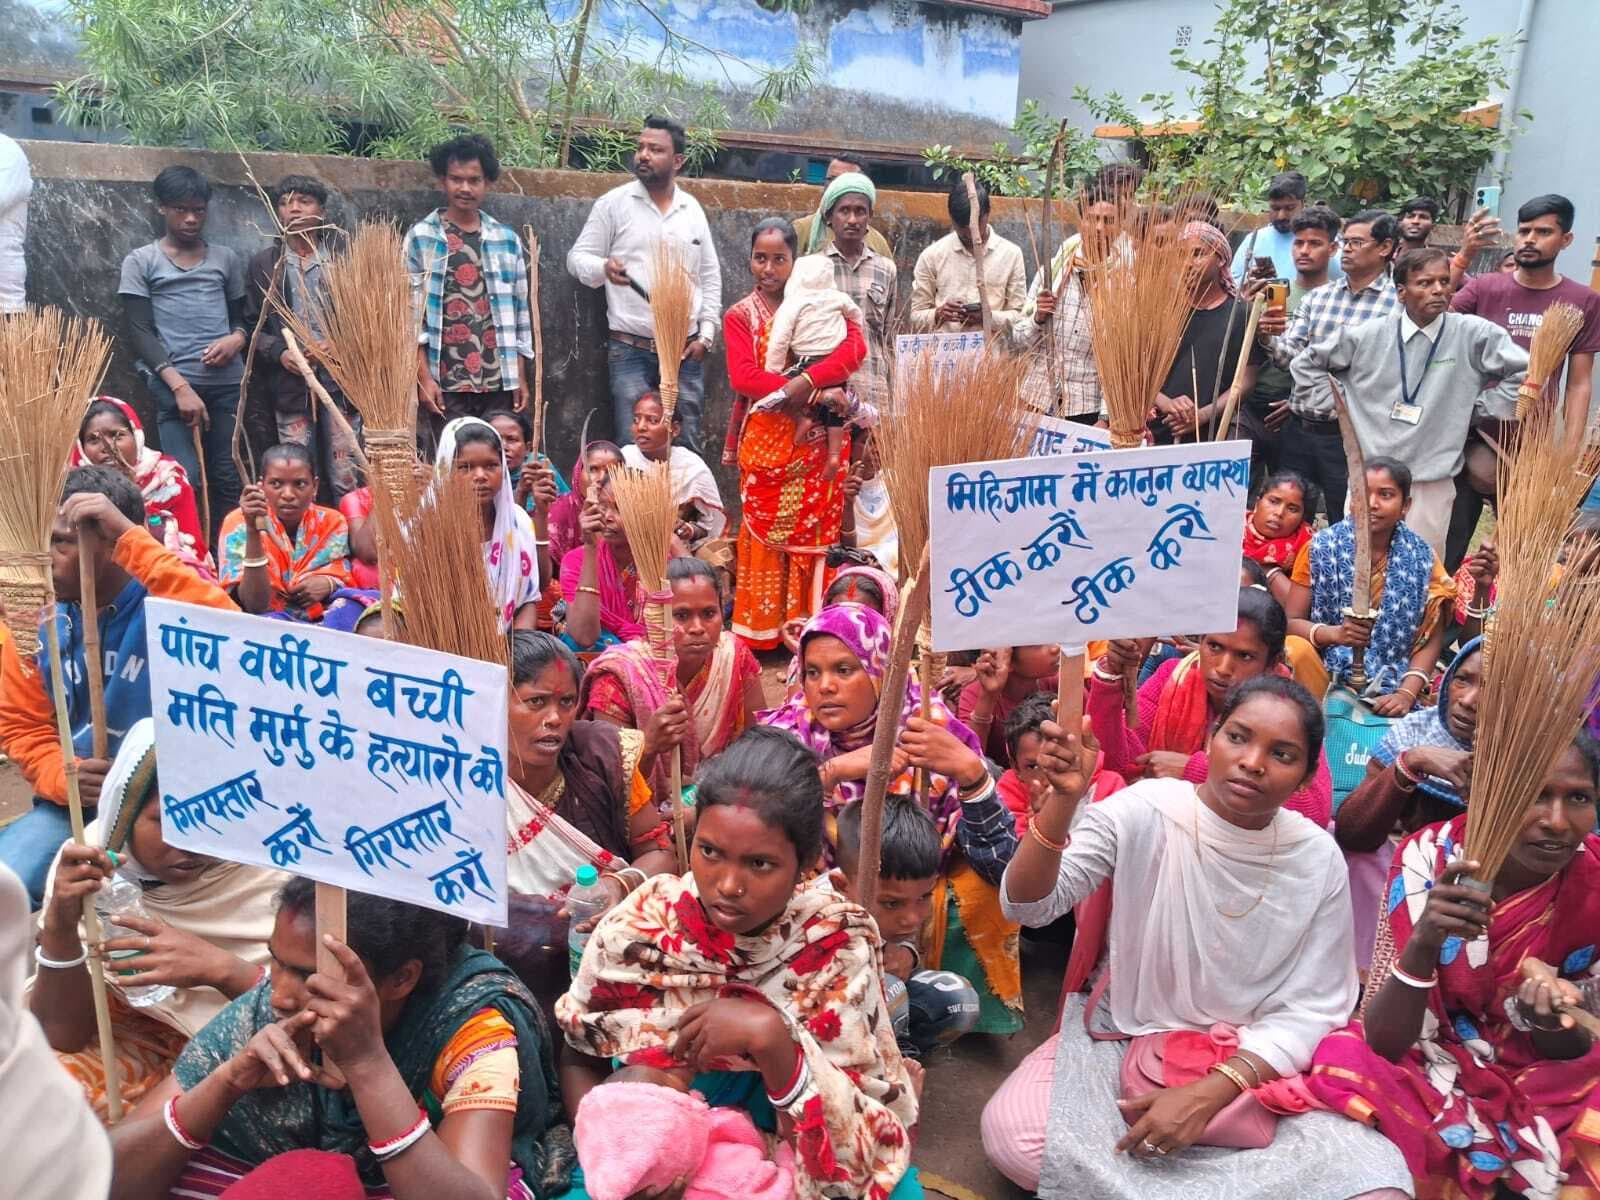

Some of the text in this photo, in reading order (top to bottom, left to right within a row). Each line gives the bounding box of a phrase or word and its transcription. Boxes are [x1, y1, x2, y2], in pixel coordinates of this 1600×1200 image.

[1509, 312, 1543, 326] CHANG
[946, 470, 1065, 523] मिहिजाम
[1071, 462, 1103, 503] में
[1105, 465, 1183, 506] कानुन
[159, 616, 230, 673] पांच
[239, 633, 348, 699] वर्षीय
[365, 668, 475, 731] बच्ची
[168, 683, 504, 809] मति मुर्मु के हत्यारो को
[164, 769, 279, 836] गिरफ्तार
[343, 799, 472, 878] गिरफ्तार
